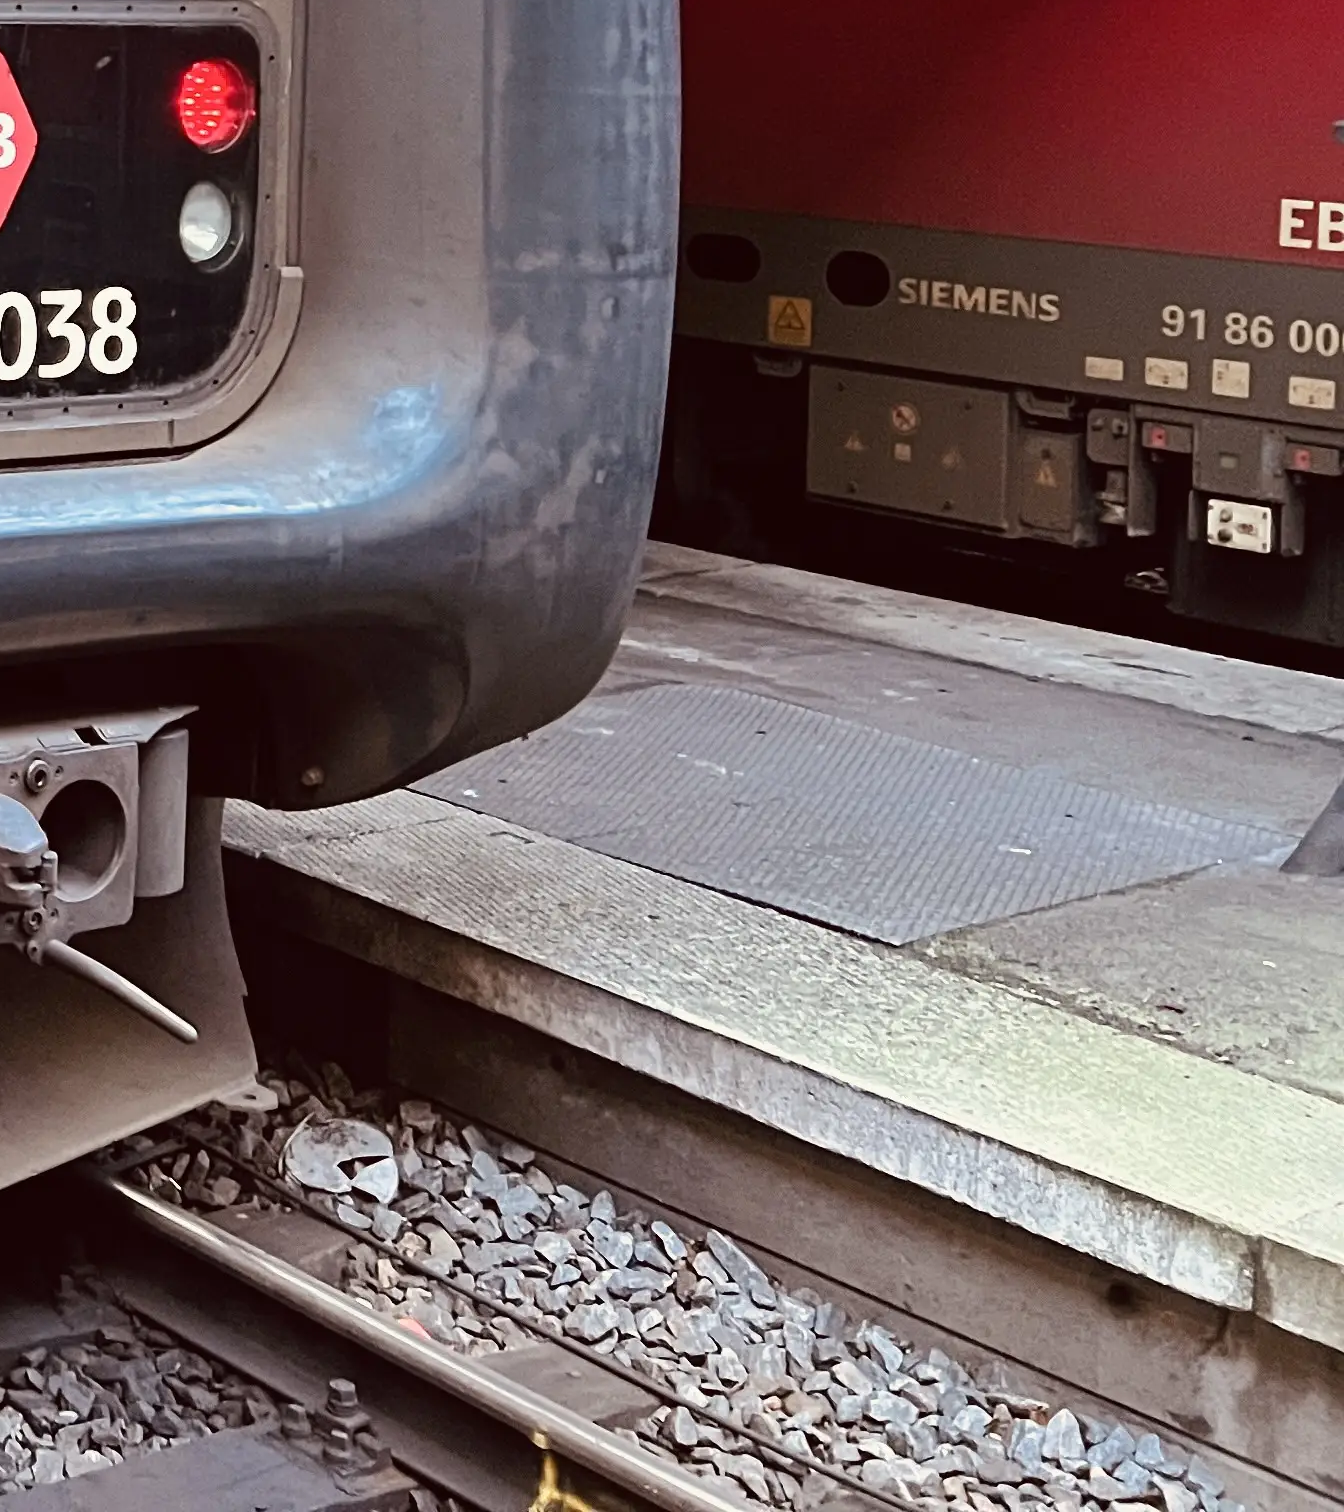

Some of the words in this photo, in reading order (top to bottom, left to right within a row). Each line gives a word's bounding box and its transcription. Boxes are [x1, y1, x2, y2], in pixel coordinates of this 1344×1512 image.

[1278, 198, 1344, 252] EB
[898, 277, 1061, 322] SIEMENS
[1162, 304, 1206, 340] 91
[1224, 312, 1274, 348] 86
[1289, 319, 1344, 357] 00
